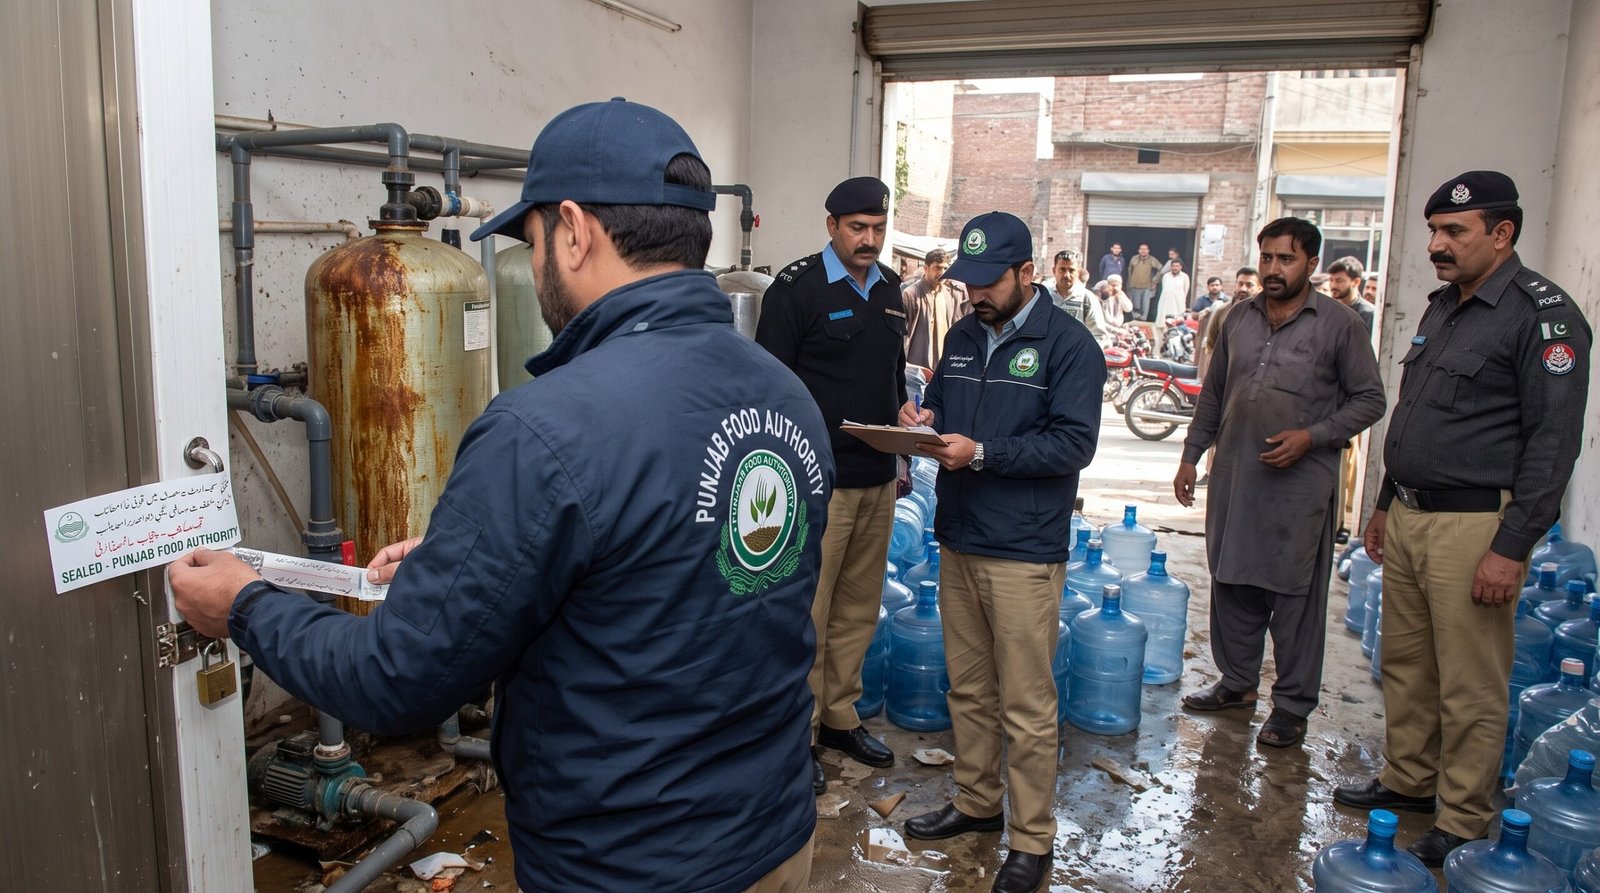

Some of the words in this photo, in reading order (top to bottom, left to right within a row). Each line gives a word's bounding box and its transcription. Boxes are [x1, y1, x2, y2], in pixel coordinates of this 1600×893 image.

[695, 432, 730, 523] PUNJAB
[721, 407, 761, 446] FOOD
[764, 409, 824, 496] AUTHORITY
[744, 455, 762, 472] FOOD
[61, 562, 103, 584] SEALED
[112, 548, 155, 569] PUNJAB
[157, 540, 184, 558] FOOD
[186, 525, 239, 549] AUTHORITY
